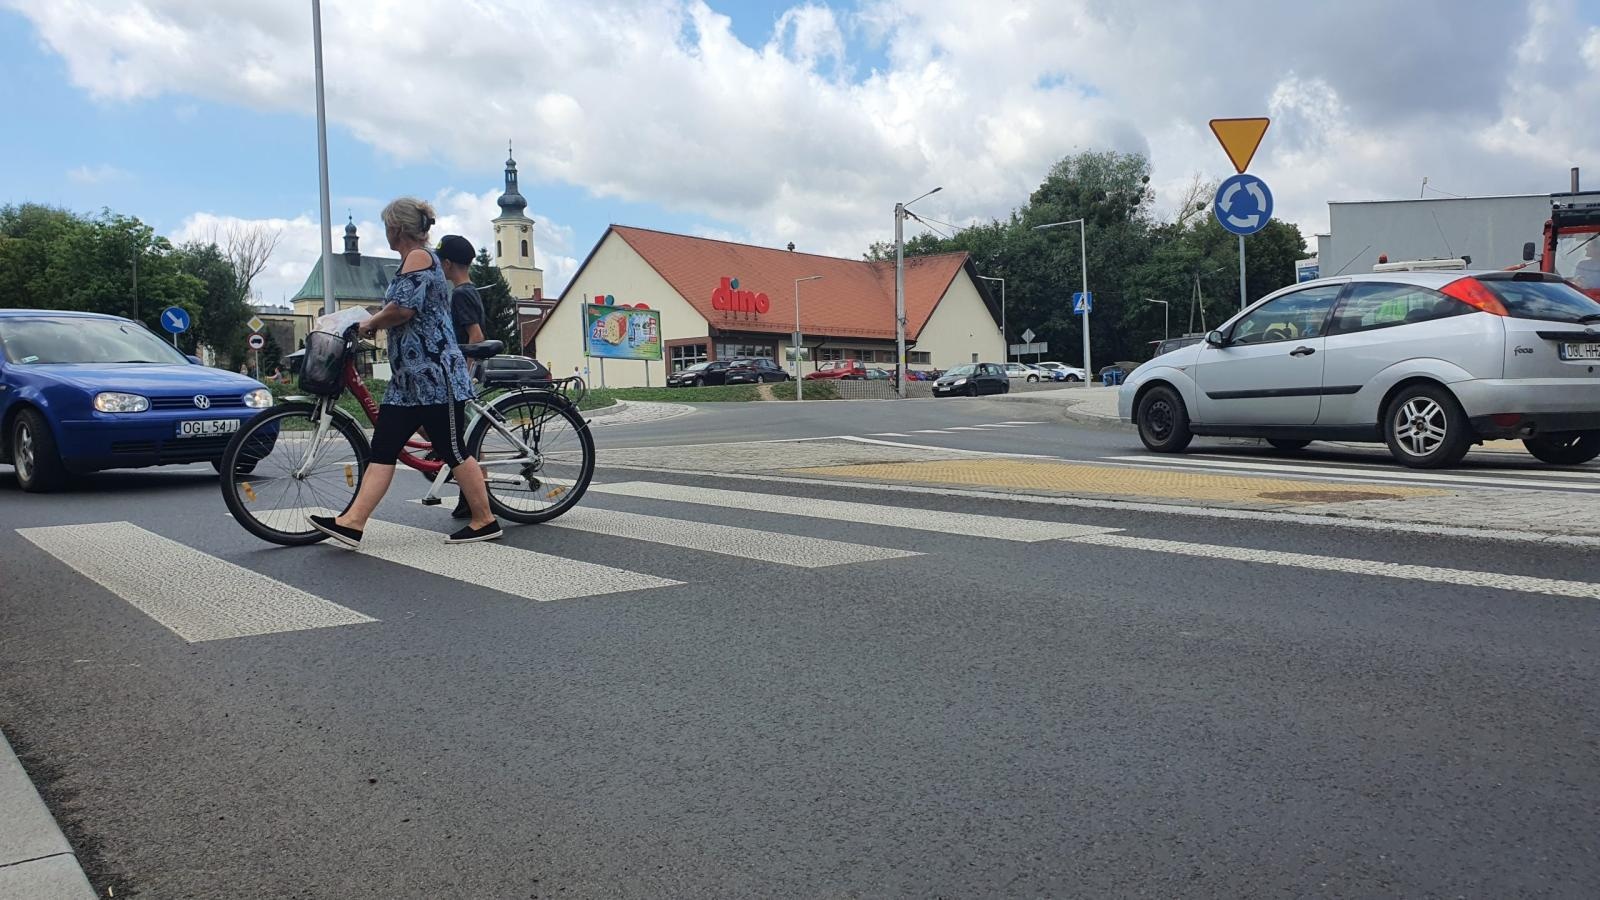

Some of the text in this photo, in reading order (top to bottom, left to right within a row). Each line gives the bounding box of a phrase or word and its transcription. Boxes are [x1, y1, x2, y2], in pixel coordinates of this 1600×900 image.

[712, 276, 769, 314] dino
[1567, 344, 1583, 357] OGL
[183, 422, 208, 434] OGL
